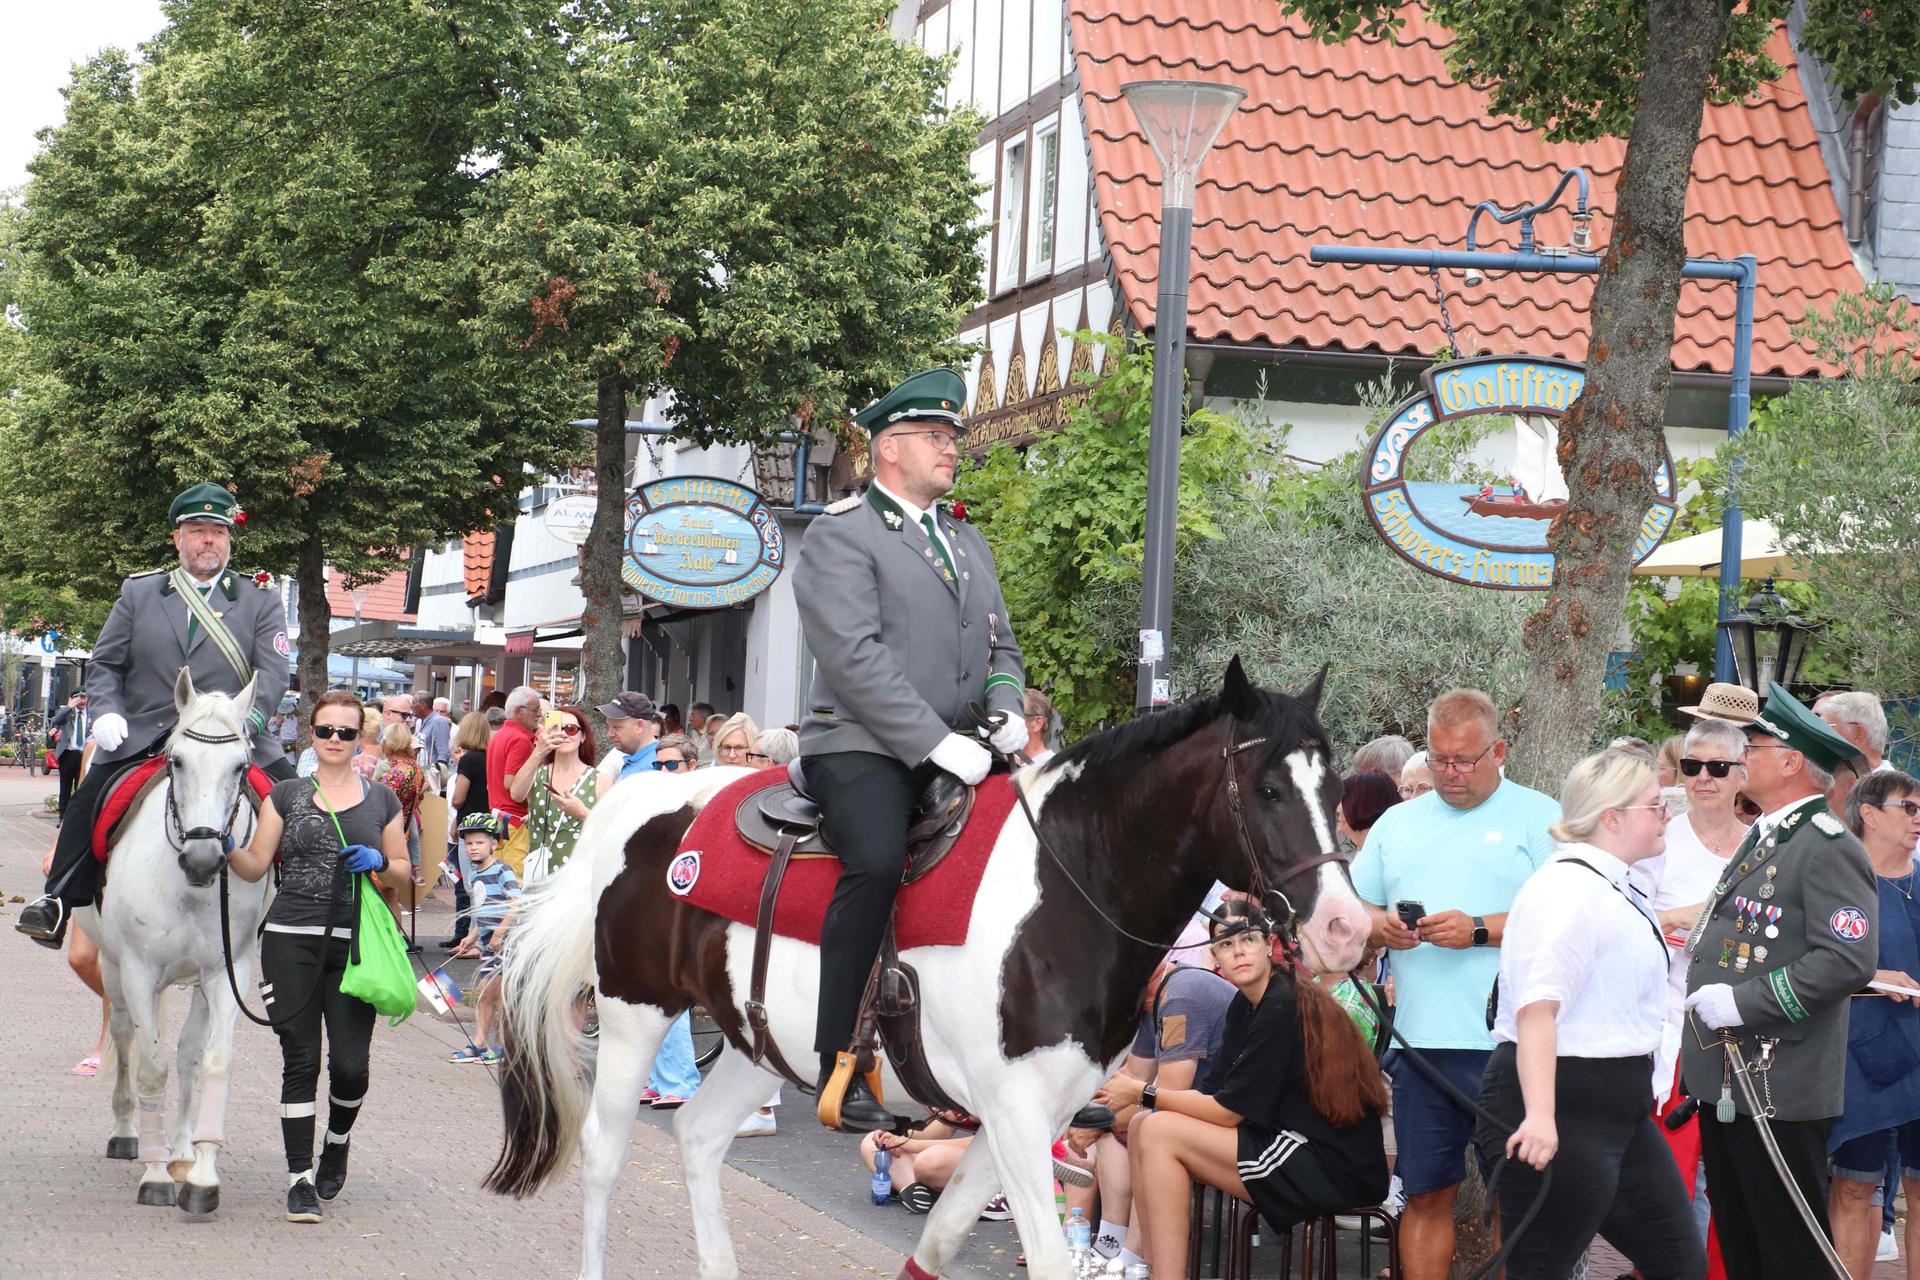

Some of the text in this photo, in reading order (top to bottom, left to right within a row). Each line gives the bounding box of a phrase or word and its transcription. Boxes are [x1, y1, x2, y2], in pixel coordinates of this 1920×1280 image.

[1441, 364, 1579, 411] Gaststät
[654, 529, 674, 544] der
[679, 552, 715, 570] Aale
